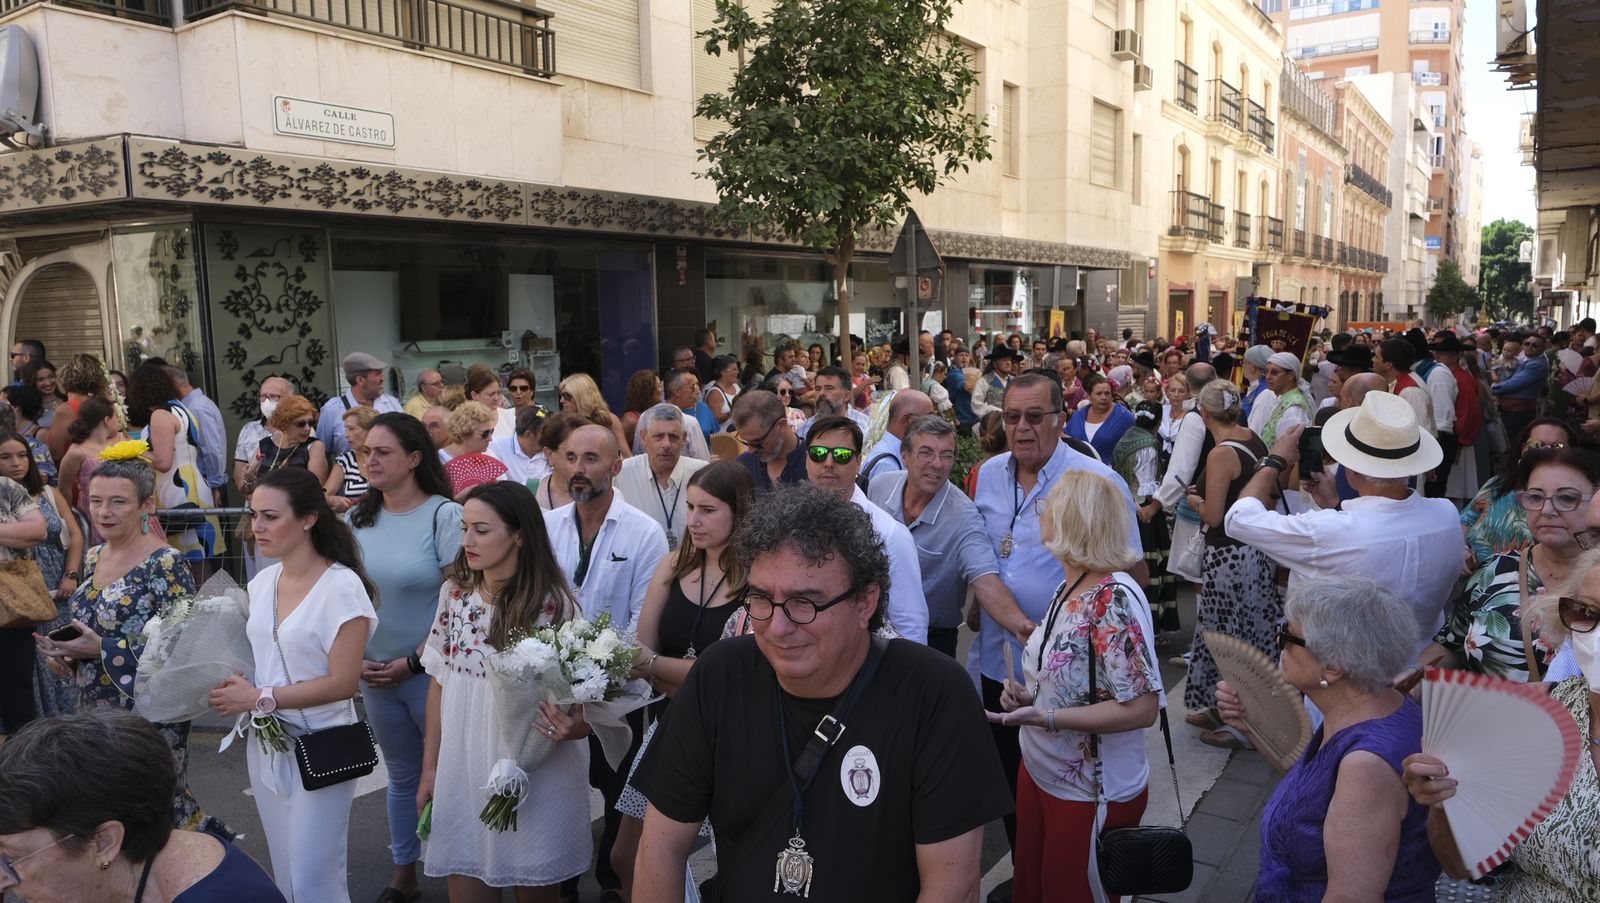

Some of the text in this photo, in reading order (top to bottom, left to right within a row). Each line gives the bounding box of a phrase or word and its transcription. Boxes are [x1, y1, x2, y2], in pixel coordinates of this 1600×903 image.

[324, 108, 357, 121] CALLE
[285, 114, 387, 142] ÁLVAREZ DE CASTRO
